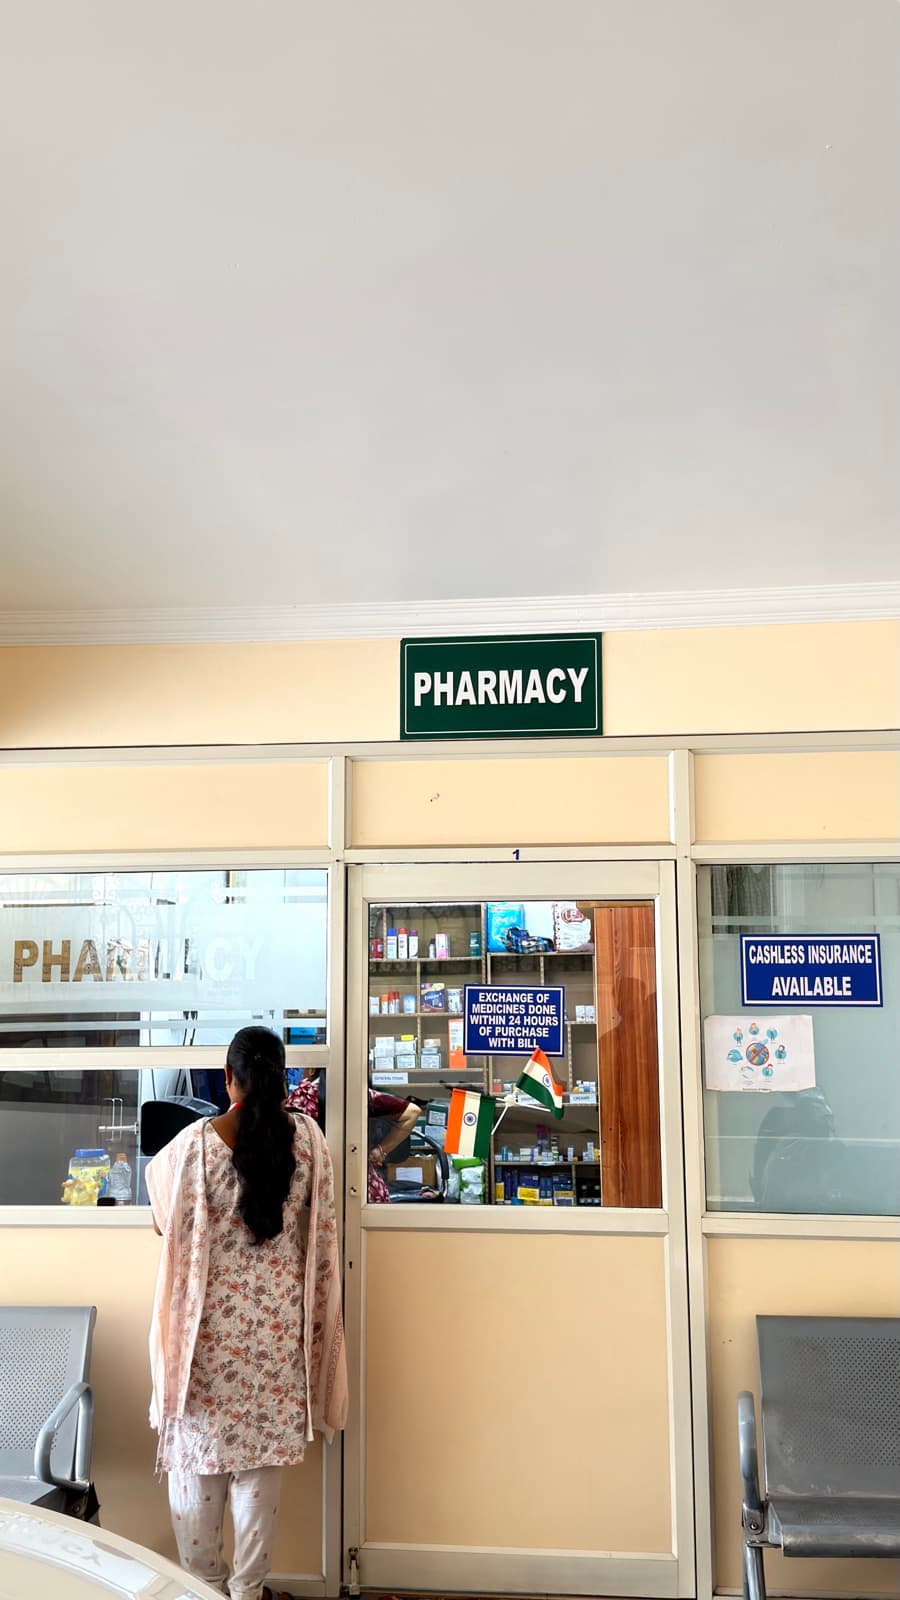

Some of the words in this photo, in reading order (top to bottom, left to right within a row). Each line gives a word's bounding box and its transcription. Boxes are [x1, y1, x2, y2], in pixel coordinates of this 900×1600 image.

[413, 667, 589, 707] PHARMACY
[512, 849, 520, 860] 1
[749, 944, 805, 965] CASHLESS
[808, 945, 873, 965] INSURANCE
[771, 976, 852, 997] AVAILABLE
[478, 992, 534, 1003] EXCHANGE
[536, 993, 550, 1004] OF
[471, 1003, 526, 1014] MEDICINES
[528, 1004, 557, 1015] DONE
[469, 1014, 506, 1025] WITHIN
[508, 1015, 521, 1026] 24
[523, 1015, 559, 1026] HOURS
[479, 1026, 493, 1036] OF
[495, 1026, 549, 1038] PURCHASE
[488, 1037, 515, 1048] WITH
[517, 1038, 540, 1049] BILL
